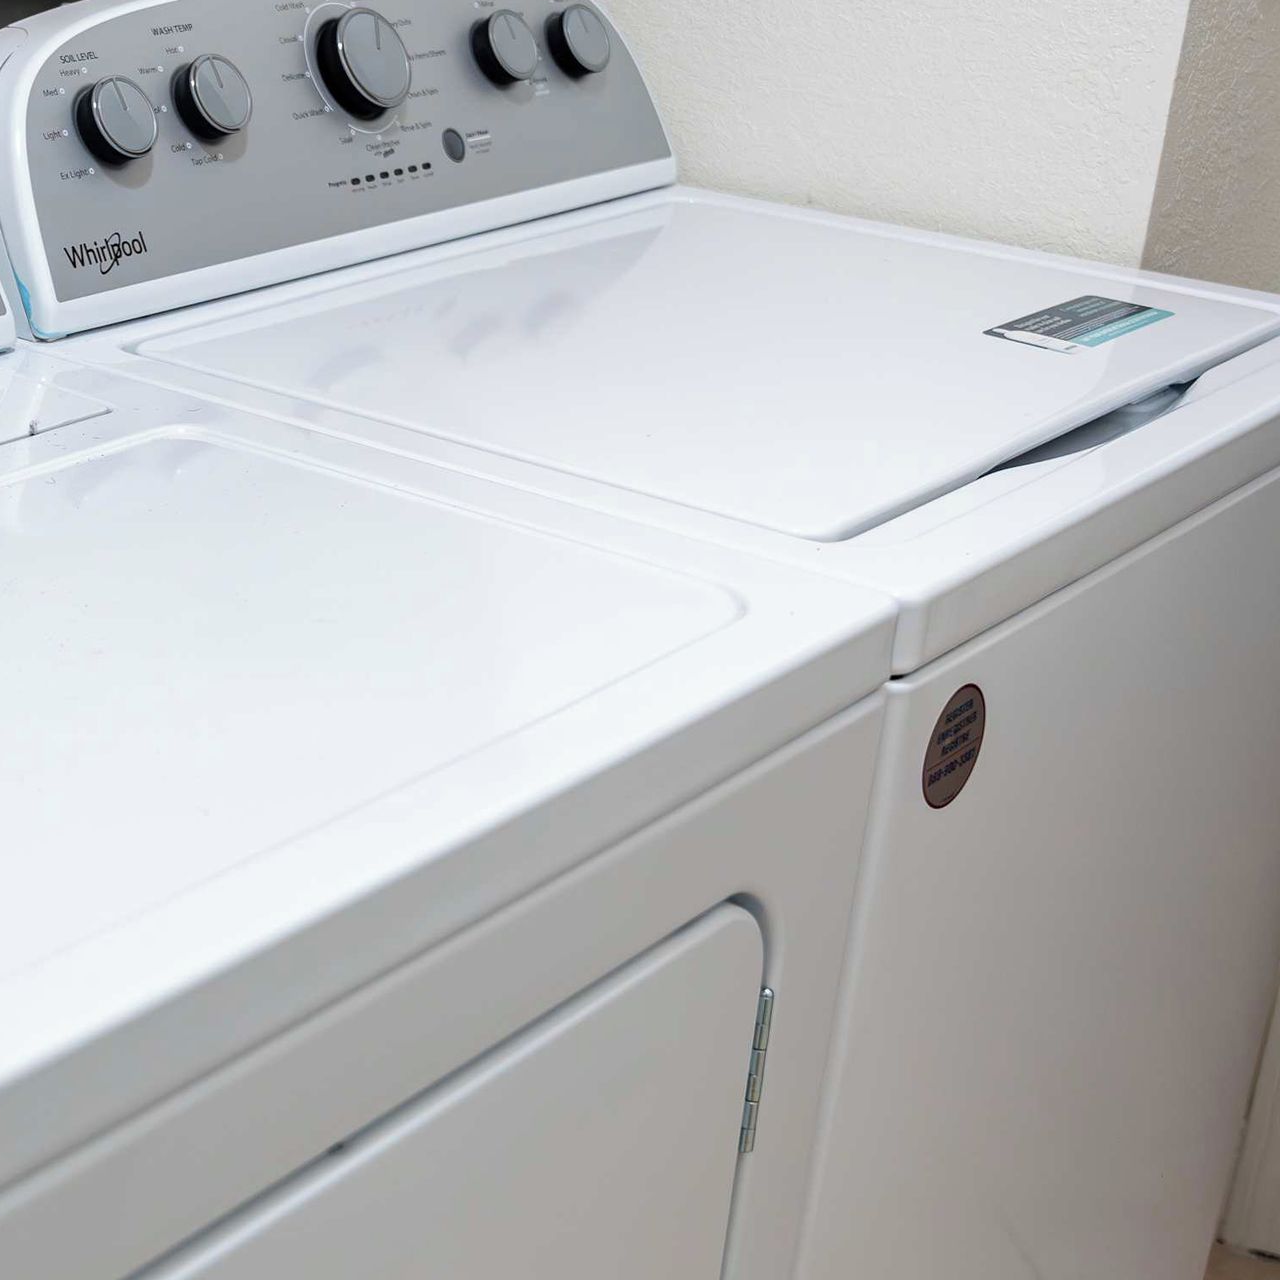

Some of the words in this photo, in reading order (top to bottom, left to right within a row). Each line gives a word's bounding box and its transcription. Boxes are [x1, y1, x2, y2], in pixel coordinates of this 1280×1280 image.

[151, 26, 173, 36] WASH
[174, 23, 193, 33] TEMP
[60, 55, 76, 64] SOIL
[76, 52, 98, 62] LEVEL
[42, 88, 59, 96] Med
[43, 131, 62, 142] Light
[171, 144, 186, 154] Cold
[192, 156, 204, 166] Tap
[204, 154, 218, 164] Cold
[70, 168, 88, 180] Light
[63, 231, 148, 275] Whirlpool
